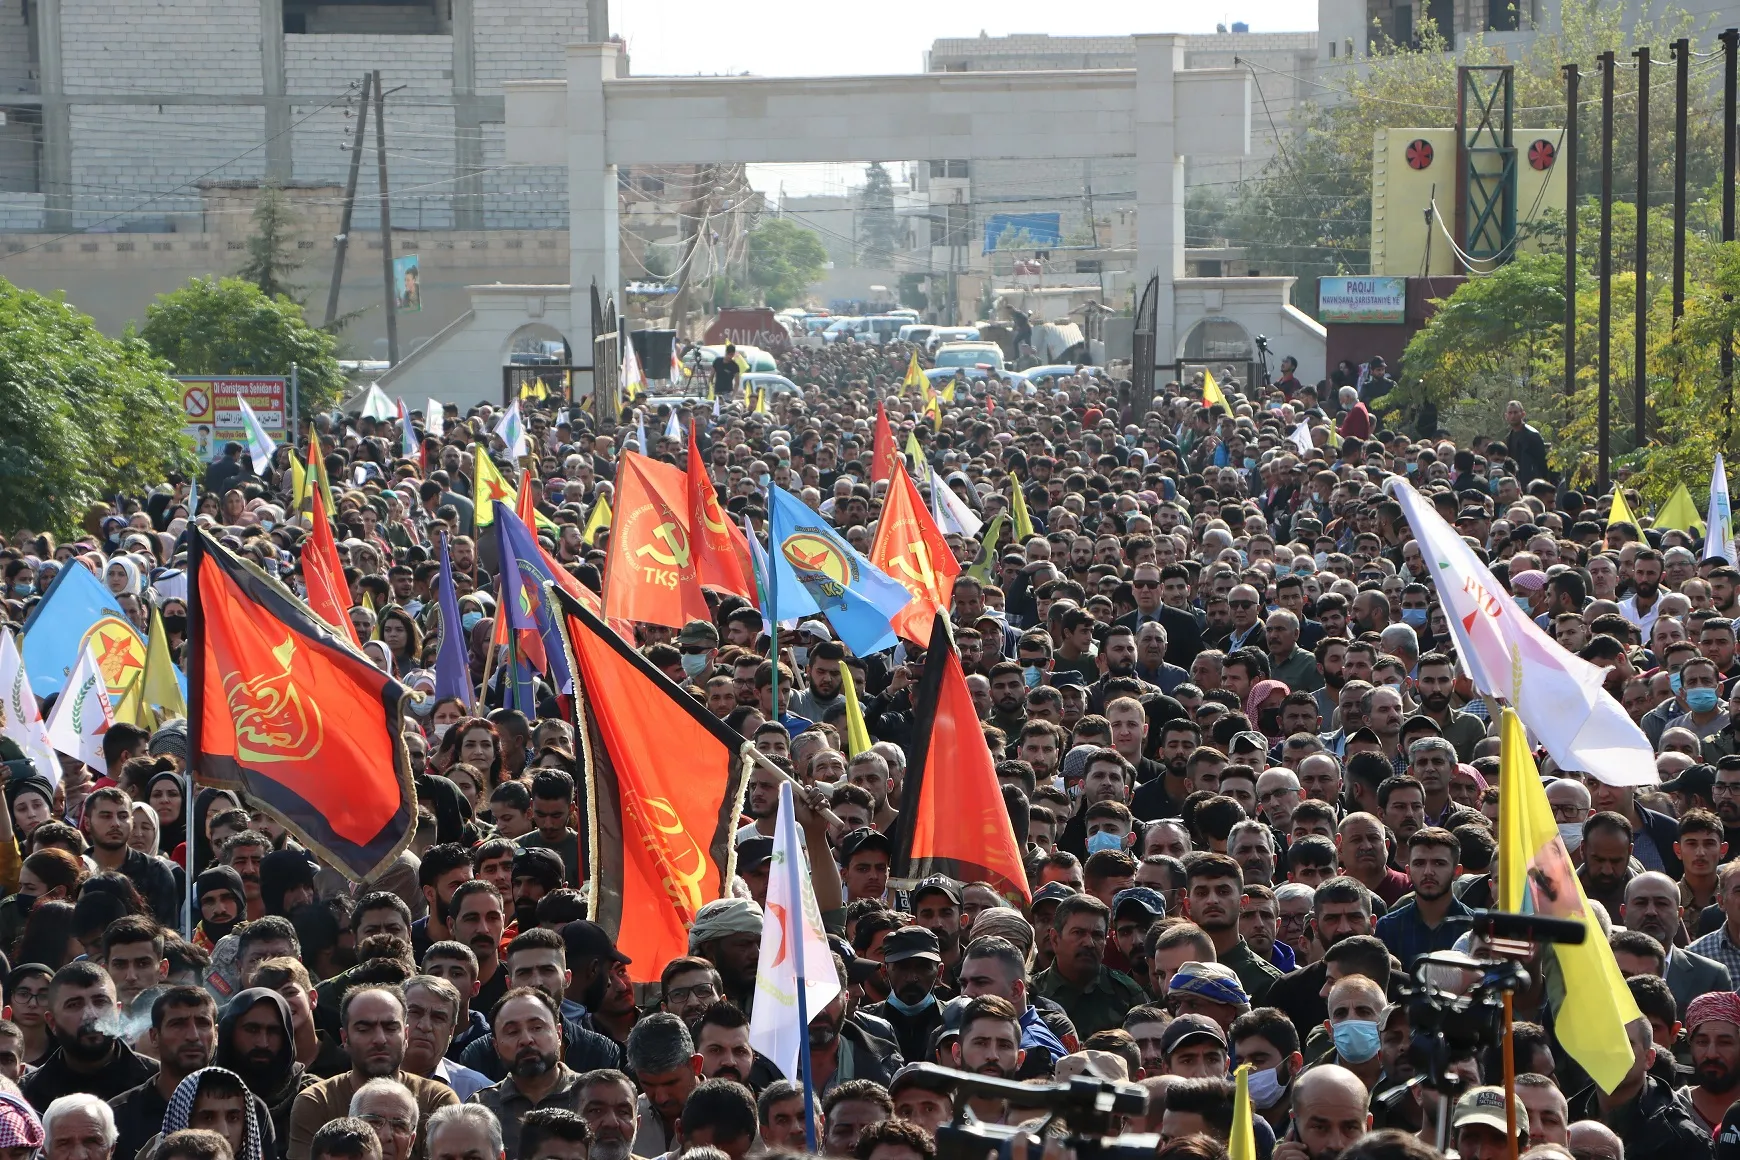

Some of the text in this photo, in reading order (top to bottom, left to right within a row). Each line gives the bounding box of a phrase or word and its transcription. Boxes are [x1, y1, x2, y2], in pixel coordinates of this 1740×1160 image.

[273, 382, 280, 393] de
[643, 566, 679, 590] TKŞ
[1463, 576, 1503, 618] PYD
